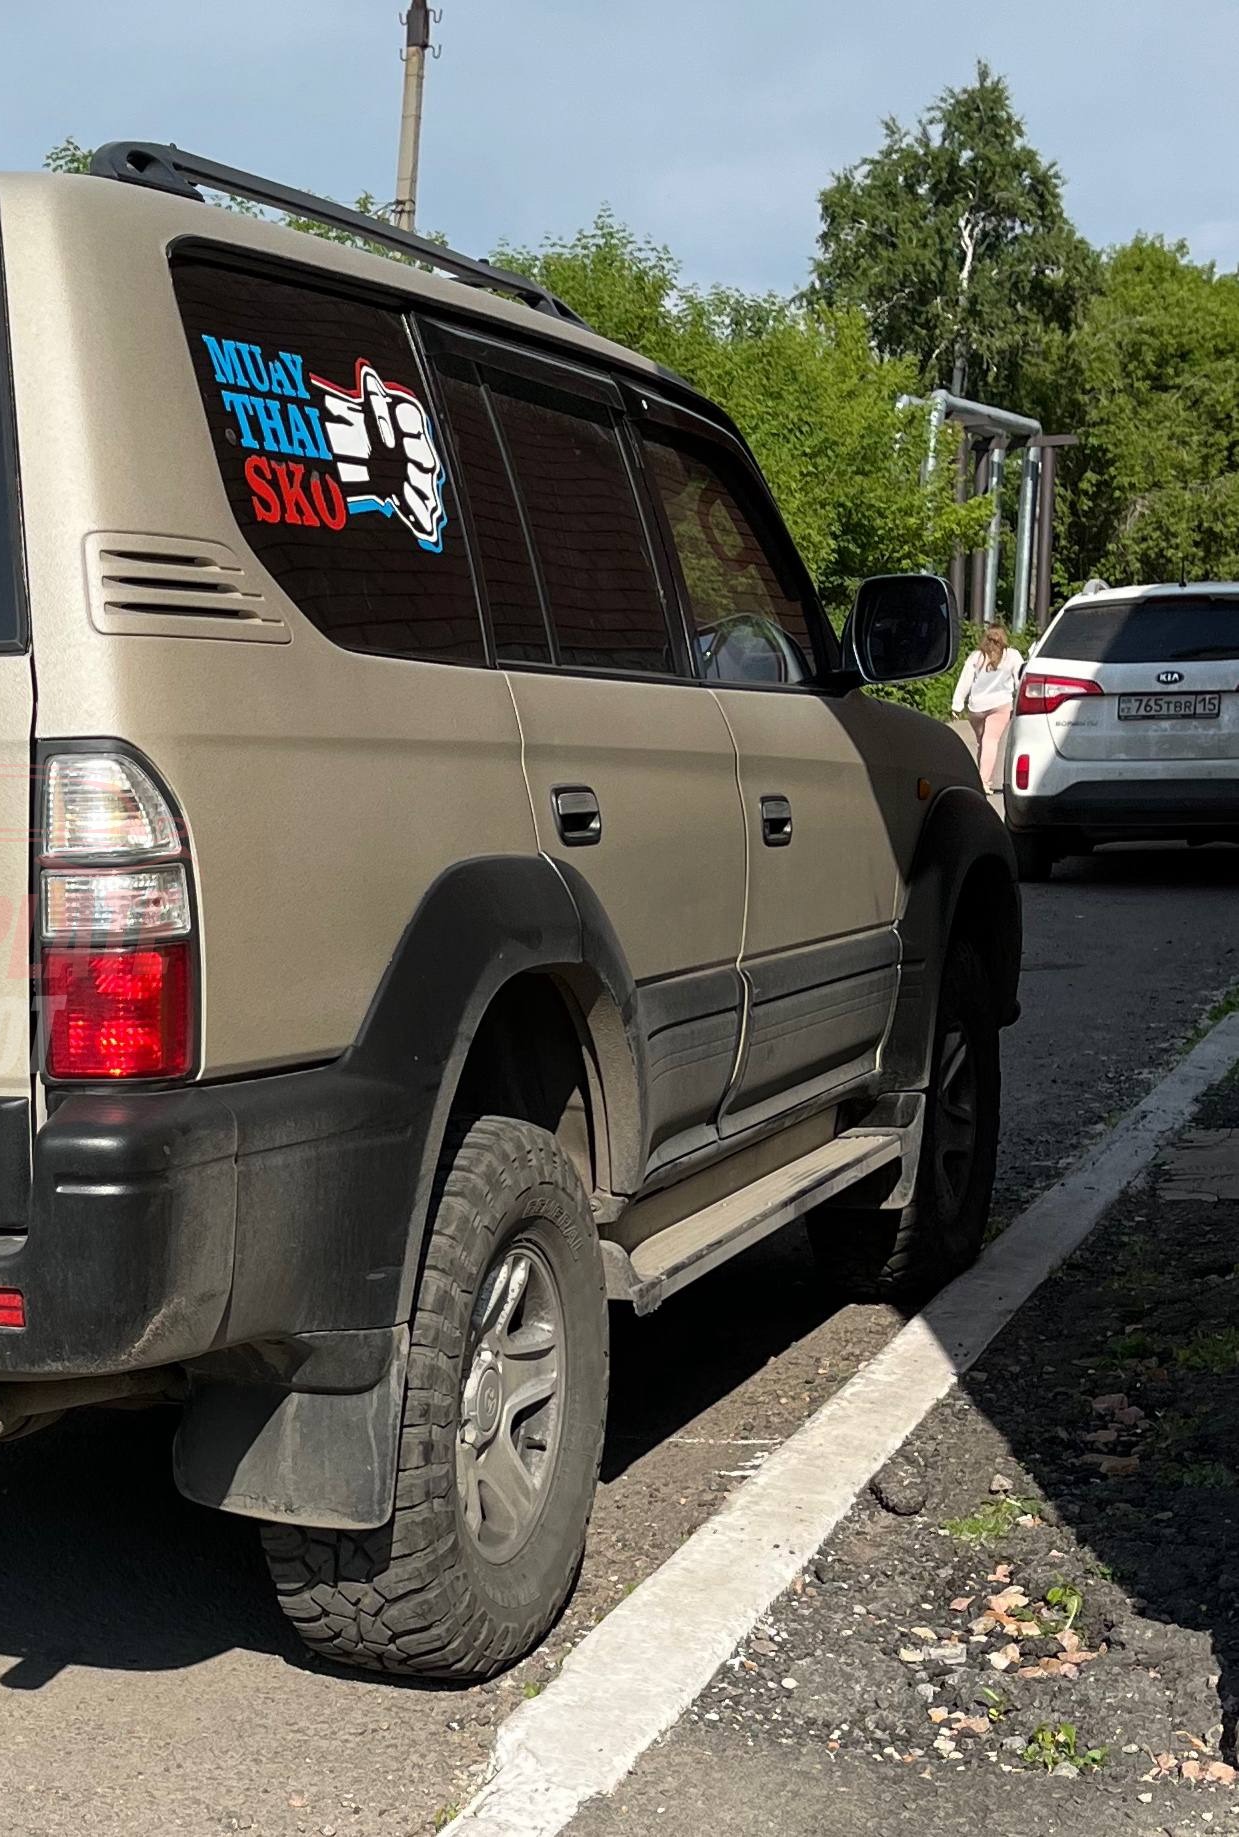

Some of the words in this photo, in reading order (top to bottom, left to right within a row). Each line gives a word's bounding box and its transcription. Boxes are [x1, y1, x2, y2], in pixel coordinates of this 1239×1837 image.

[201, 334, 311, 399] MUAY
[221, 390, 333, 460] THAI
[1159, 673, 1180, 682] KIA
